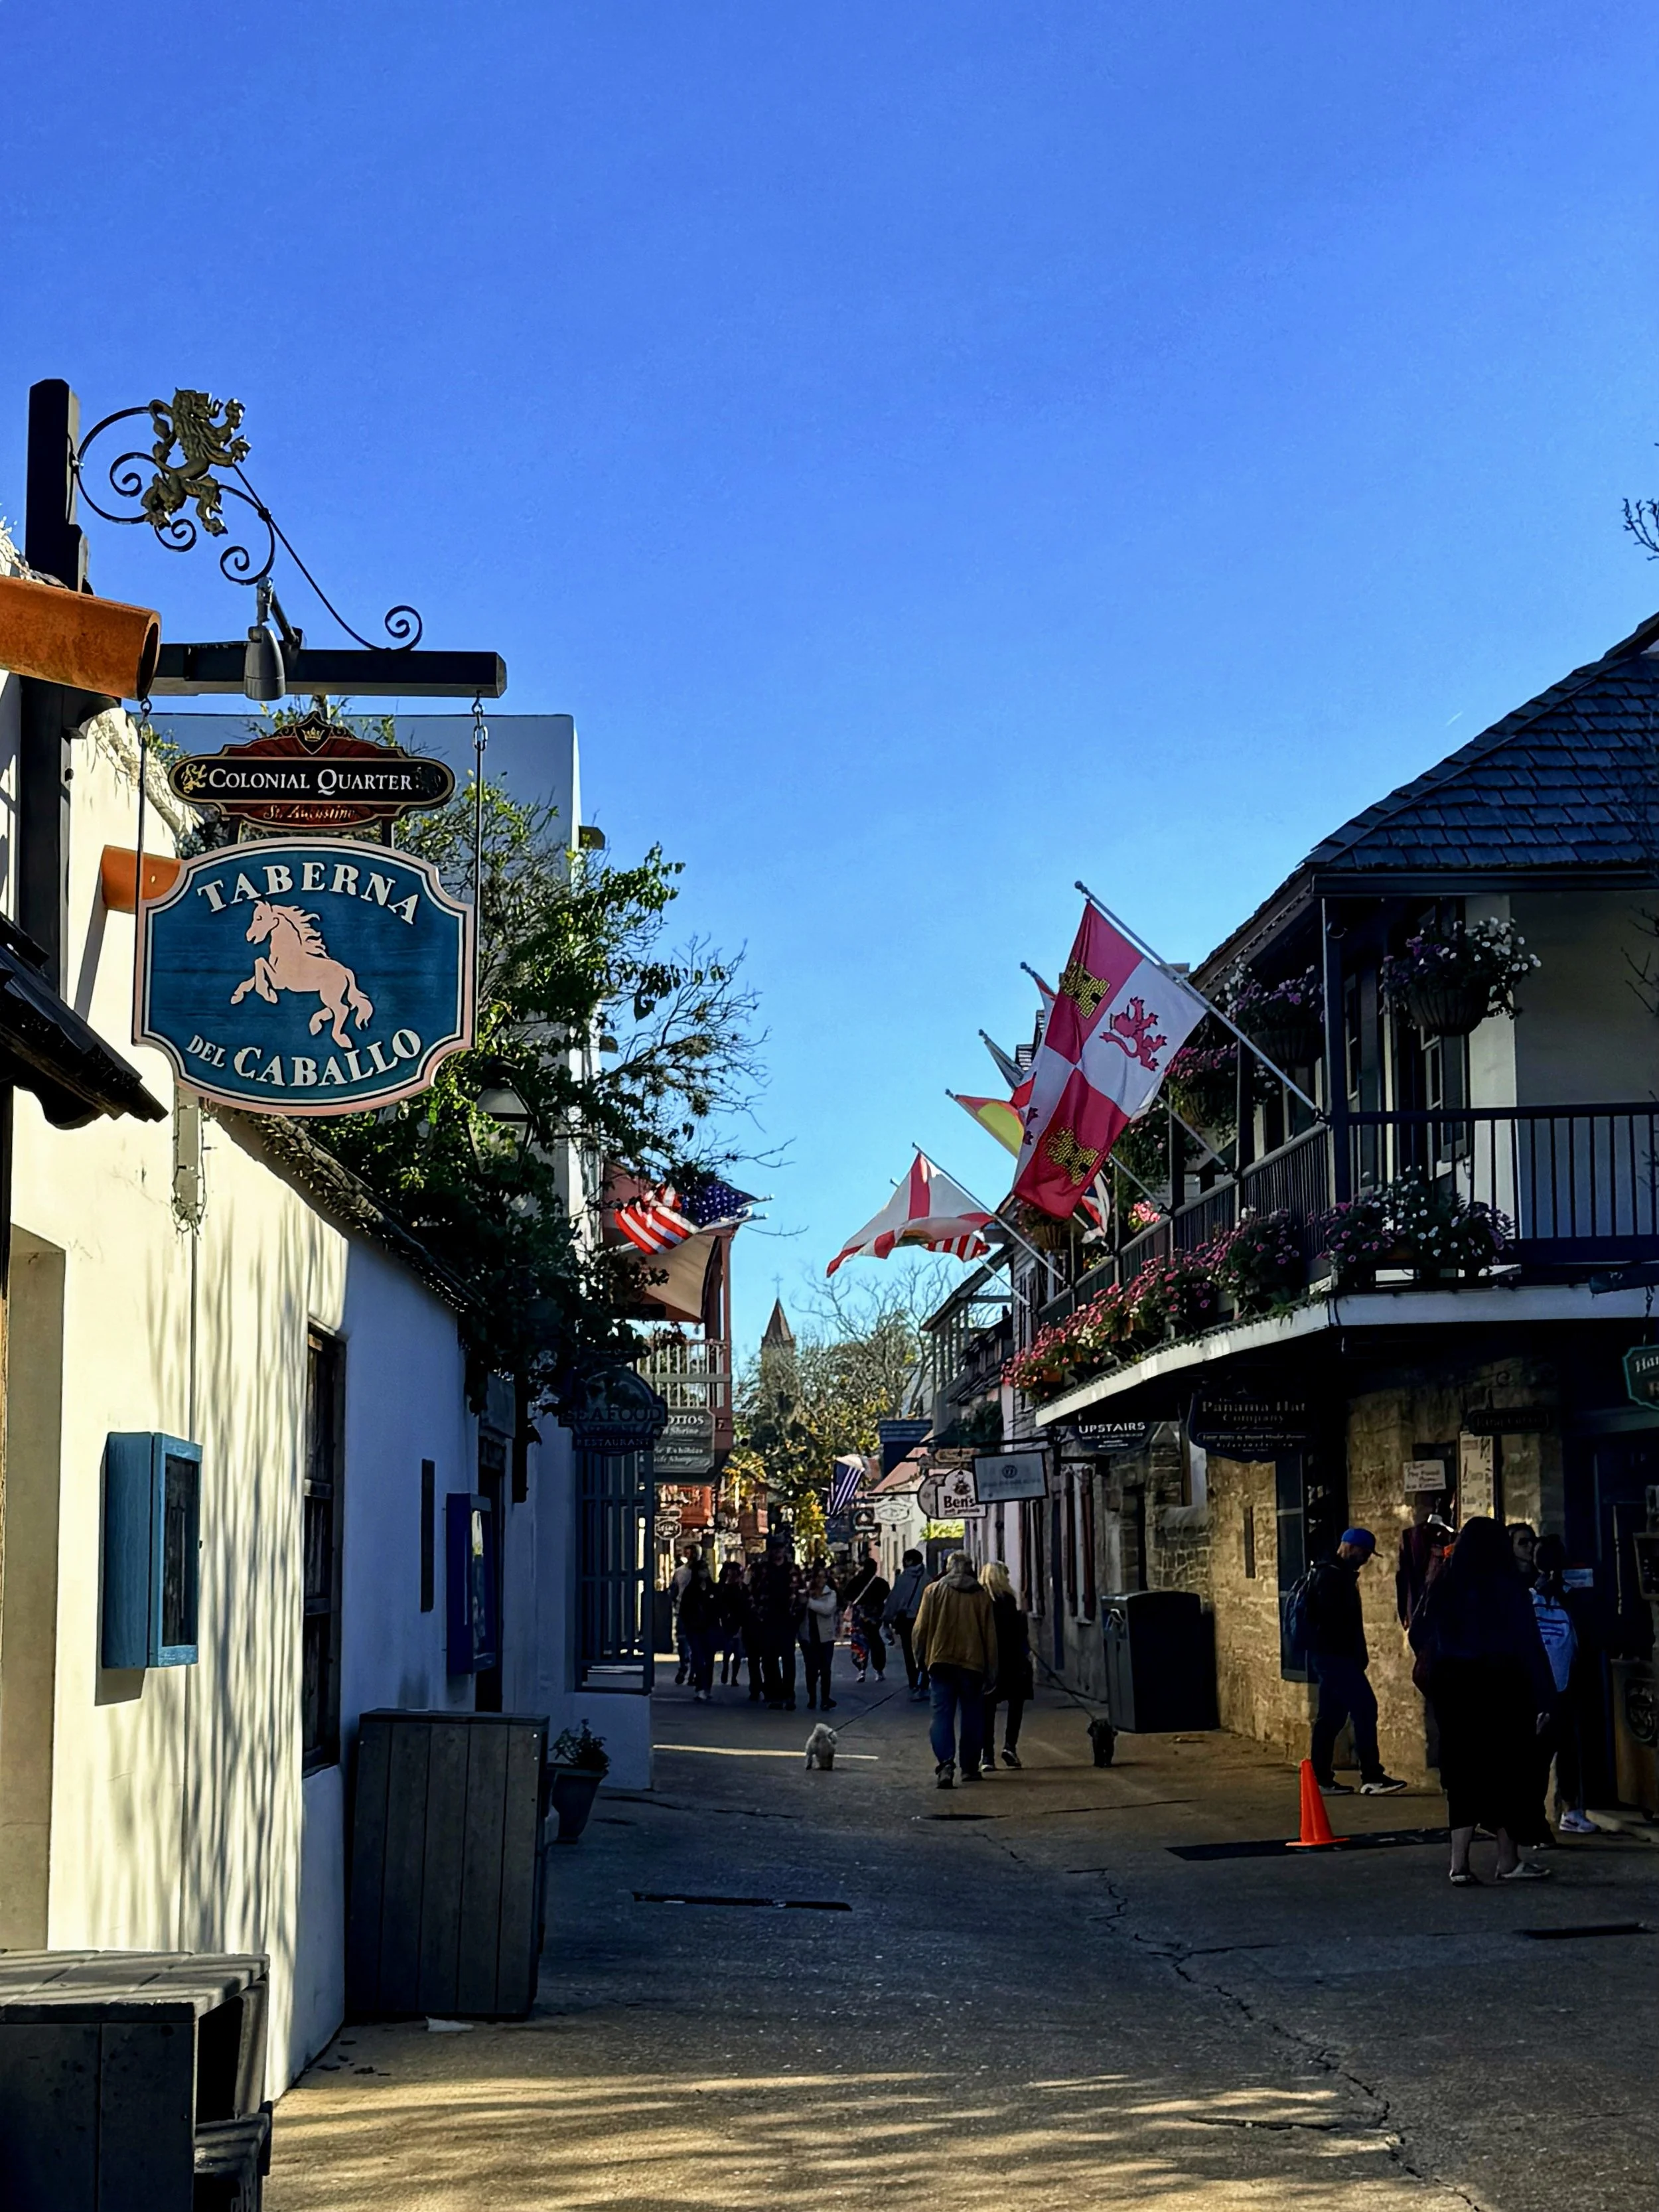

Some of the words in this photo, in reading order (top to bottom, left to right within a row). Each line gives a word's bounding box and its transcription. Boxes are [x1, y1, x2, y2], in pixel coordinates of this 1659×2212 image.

[208, 767, 311, 790] COLONIAL
[317, 768, 413, 796] QUARTER
[196, 862, 421, 925] TABERNA
[185, 1034, 225, 1069] DEL
[234, 1029, 421, 1088] CABALLO
[1202, 1400, 1269, 1412] Panama
[1276, 1400, 1307, 1412] Hat
[564, 1406, 662, 1422] SEAFOOD
[1222, 1413, 1285, 1425] Company
[1078, 1422, 1146, 1434] UPSTAIRS
[576, 1438, 650, 1447] RESTAURANT
[944, 1495, 975, 1509] Ben's
